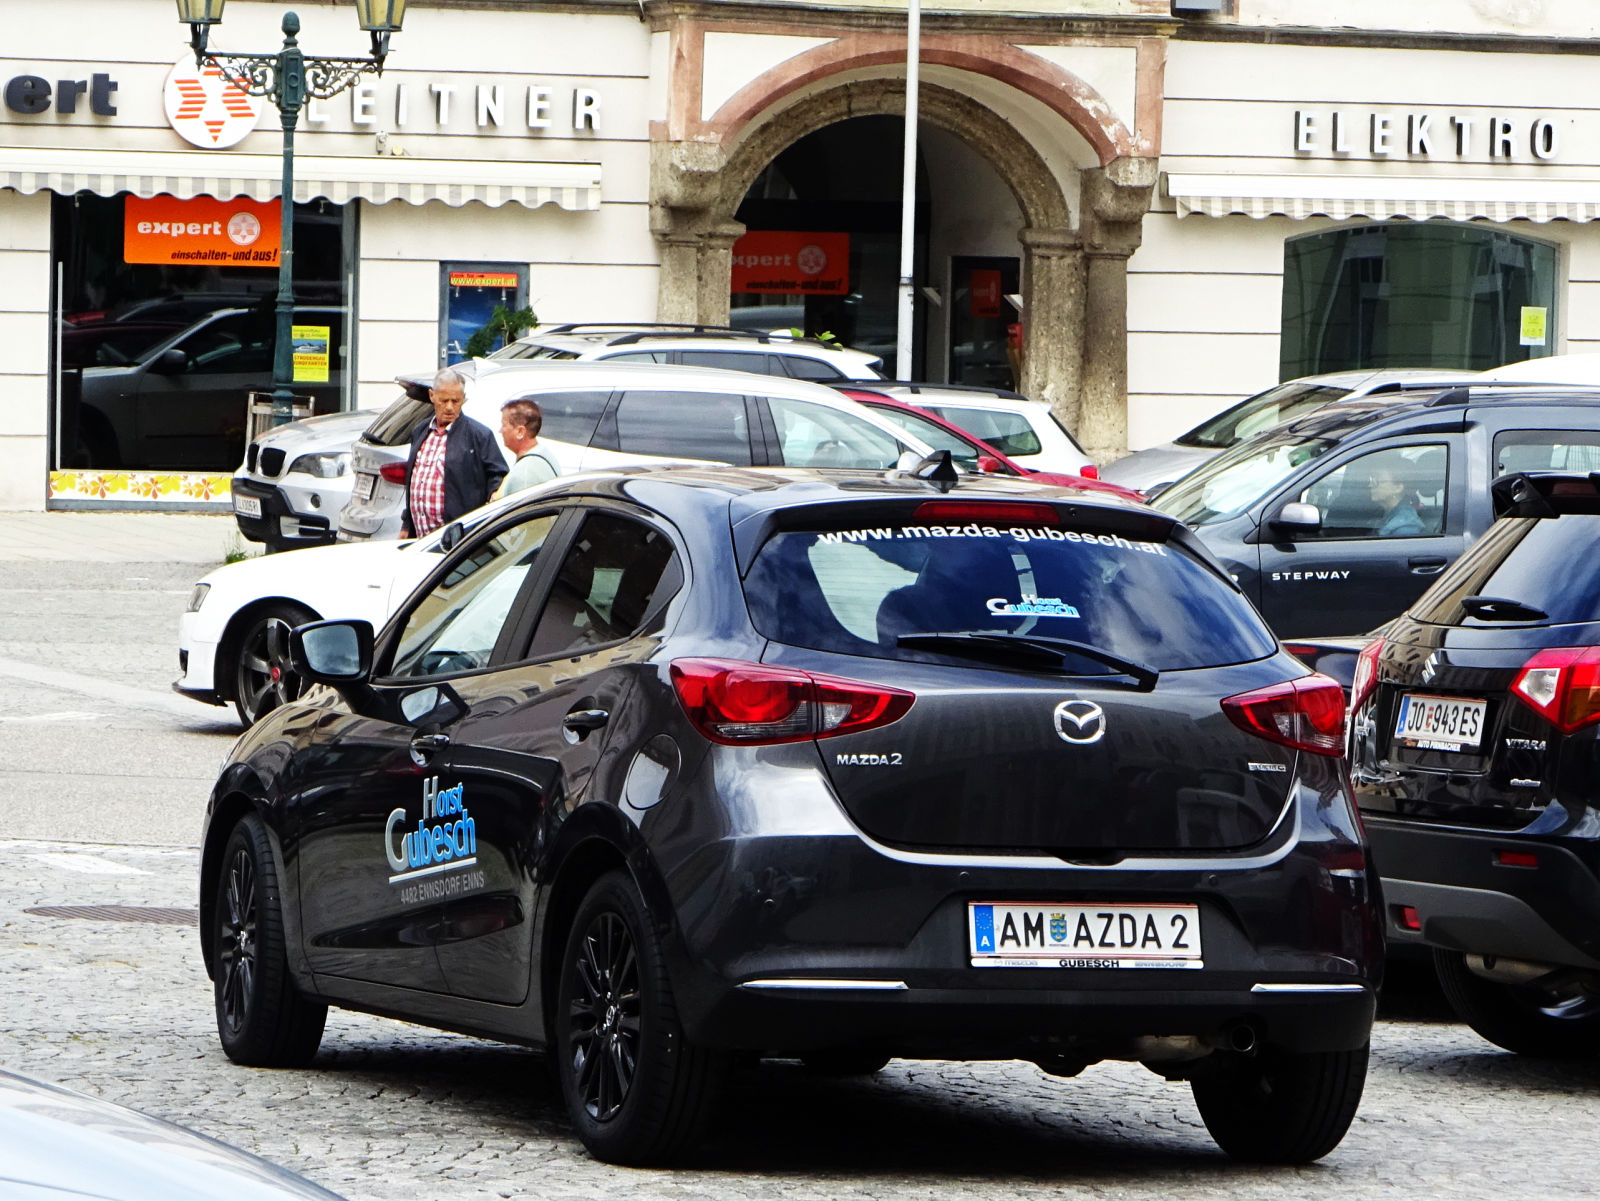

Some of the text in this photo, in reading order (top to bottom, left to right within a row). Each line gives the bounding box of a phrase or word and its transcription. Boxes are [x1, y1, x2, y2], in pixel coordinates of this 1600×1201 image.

[305, 82, 603, 131] LEITNER
[1294, 110, 1559, 160] ELEKTRO
[137, 220, 222, 237] expert
[252, 248, 278, 262] aus!
[450, 277, 517, 287] www.expert.at
[817, 523, 1167, 557] www.mazda-gubesch.at
[1271, 570, 1351, 582] STEPWAY
[986, 598, 1080, 616] Gubesch
[1407, 702, 1426, 732] JO
[1431, 703, 1460, 735] 943
[1458, 706, 1480, 737] ES
[1505, 738, 1547, 750] VITARA
[423, 775, 464, 819] Horst
[385, 807, 477, 873] Gubesch
[401, 886, 418, 904] 4482
[980, 911, 1190, 949] A AM AZDA 2
[1058, 958, 1120, 969] GUBESCH
